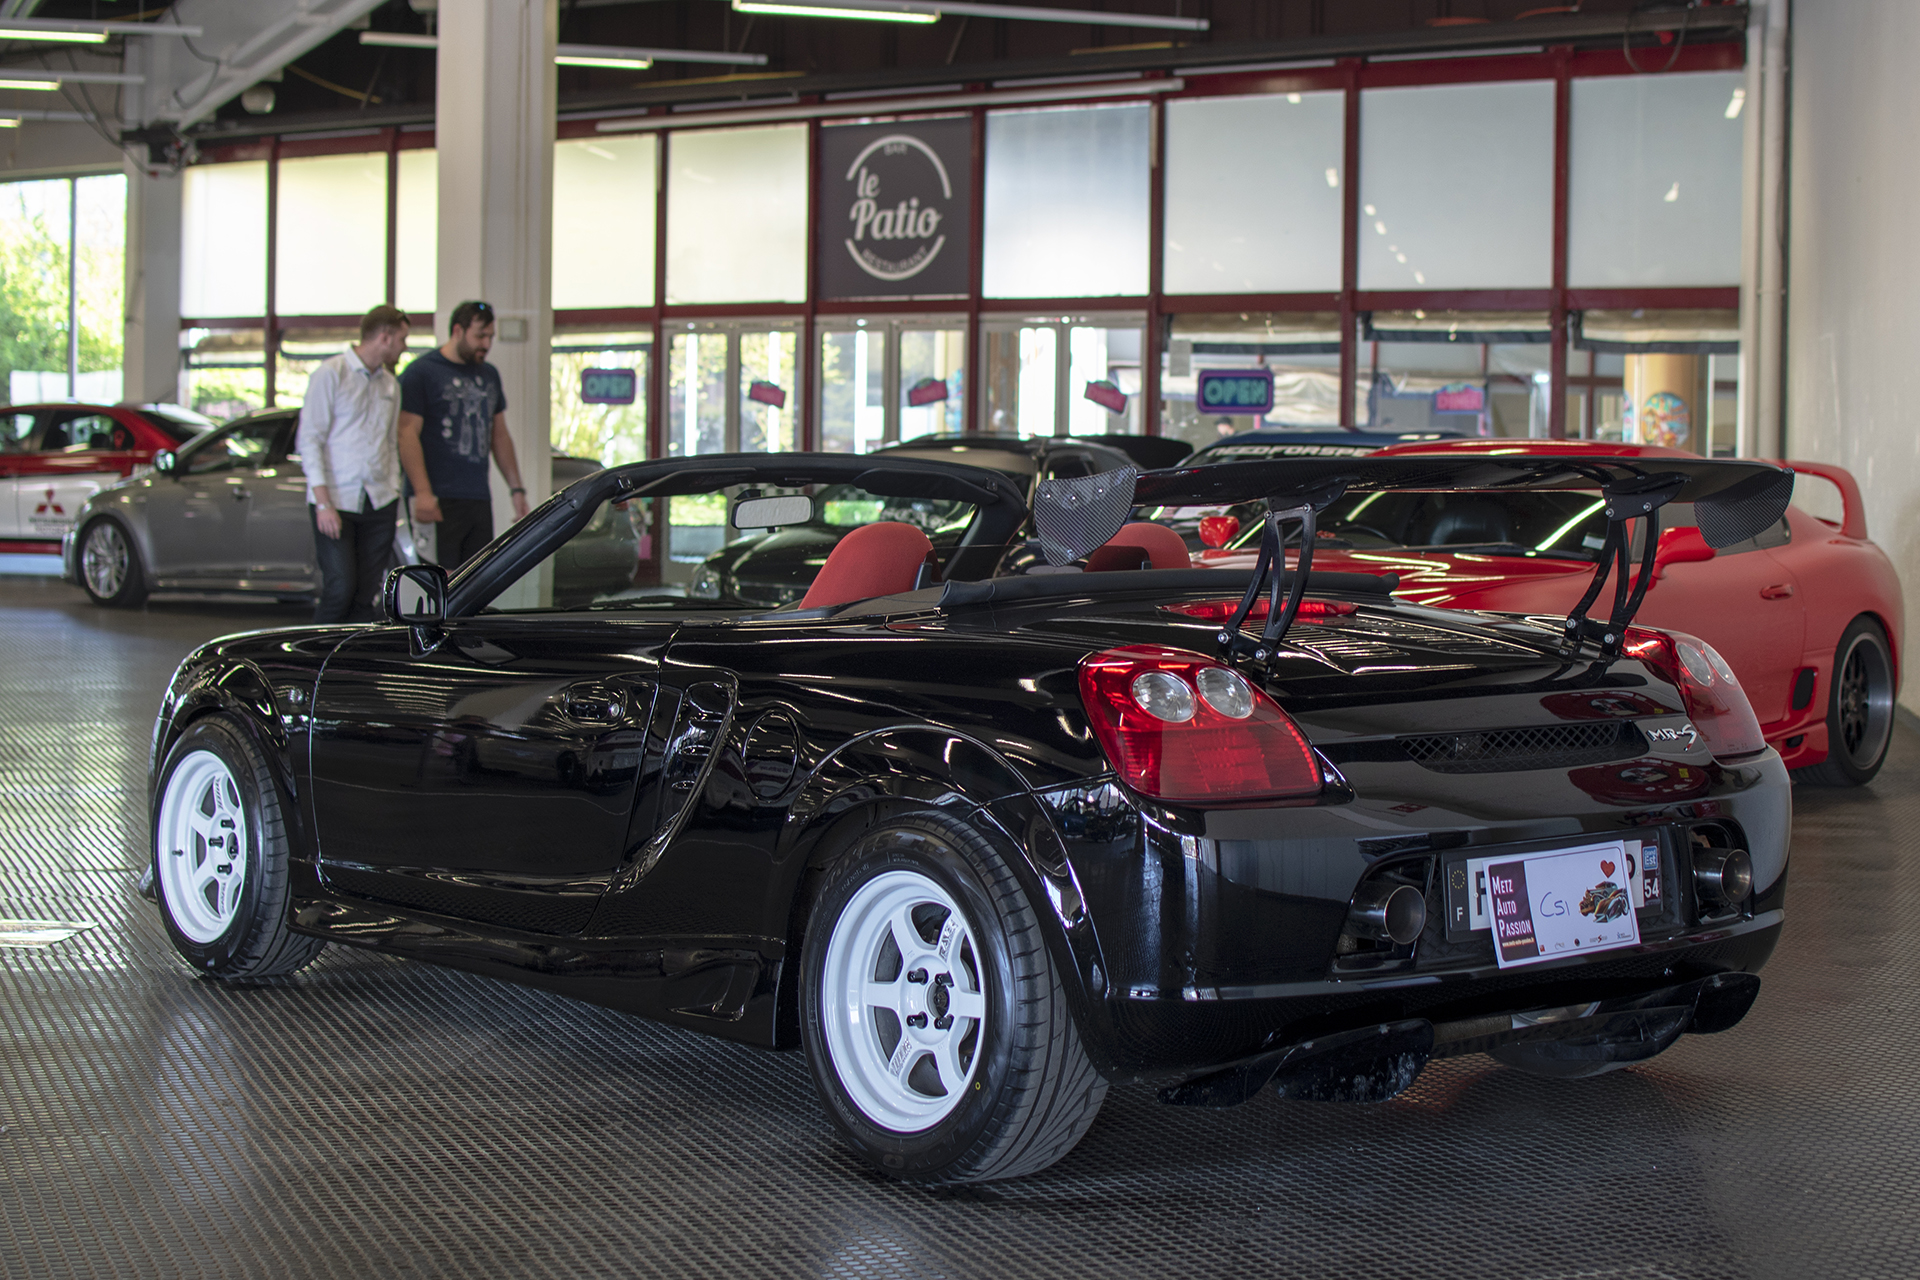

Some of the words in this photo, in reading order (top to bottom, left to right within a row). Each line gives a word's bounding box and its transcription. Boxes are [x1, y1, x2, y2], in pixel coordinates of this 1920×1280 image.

[856, 166, 881, 198] le
[849, 197, 943, 241] Patio
[862, 246, 928, 272] RESTAURANT
[585, 375, 633, 398] OPEN
[1203, 379, 1268, 405] OPEN
[1646, 723, 1698, 752] MR-S
[1644, 877, 1660, 899] 54
[1456, 906, 1464, 922] F
